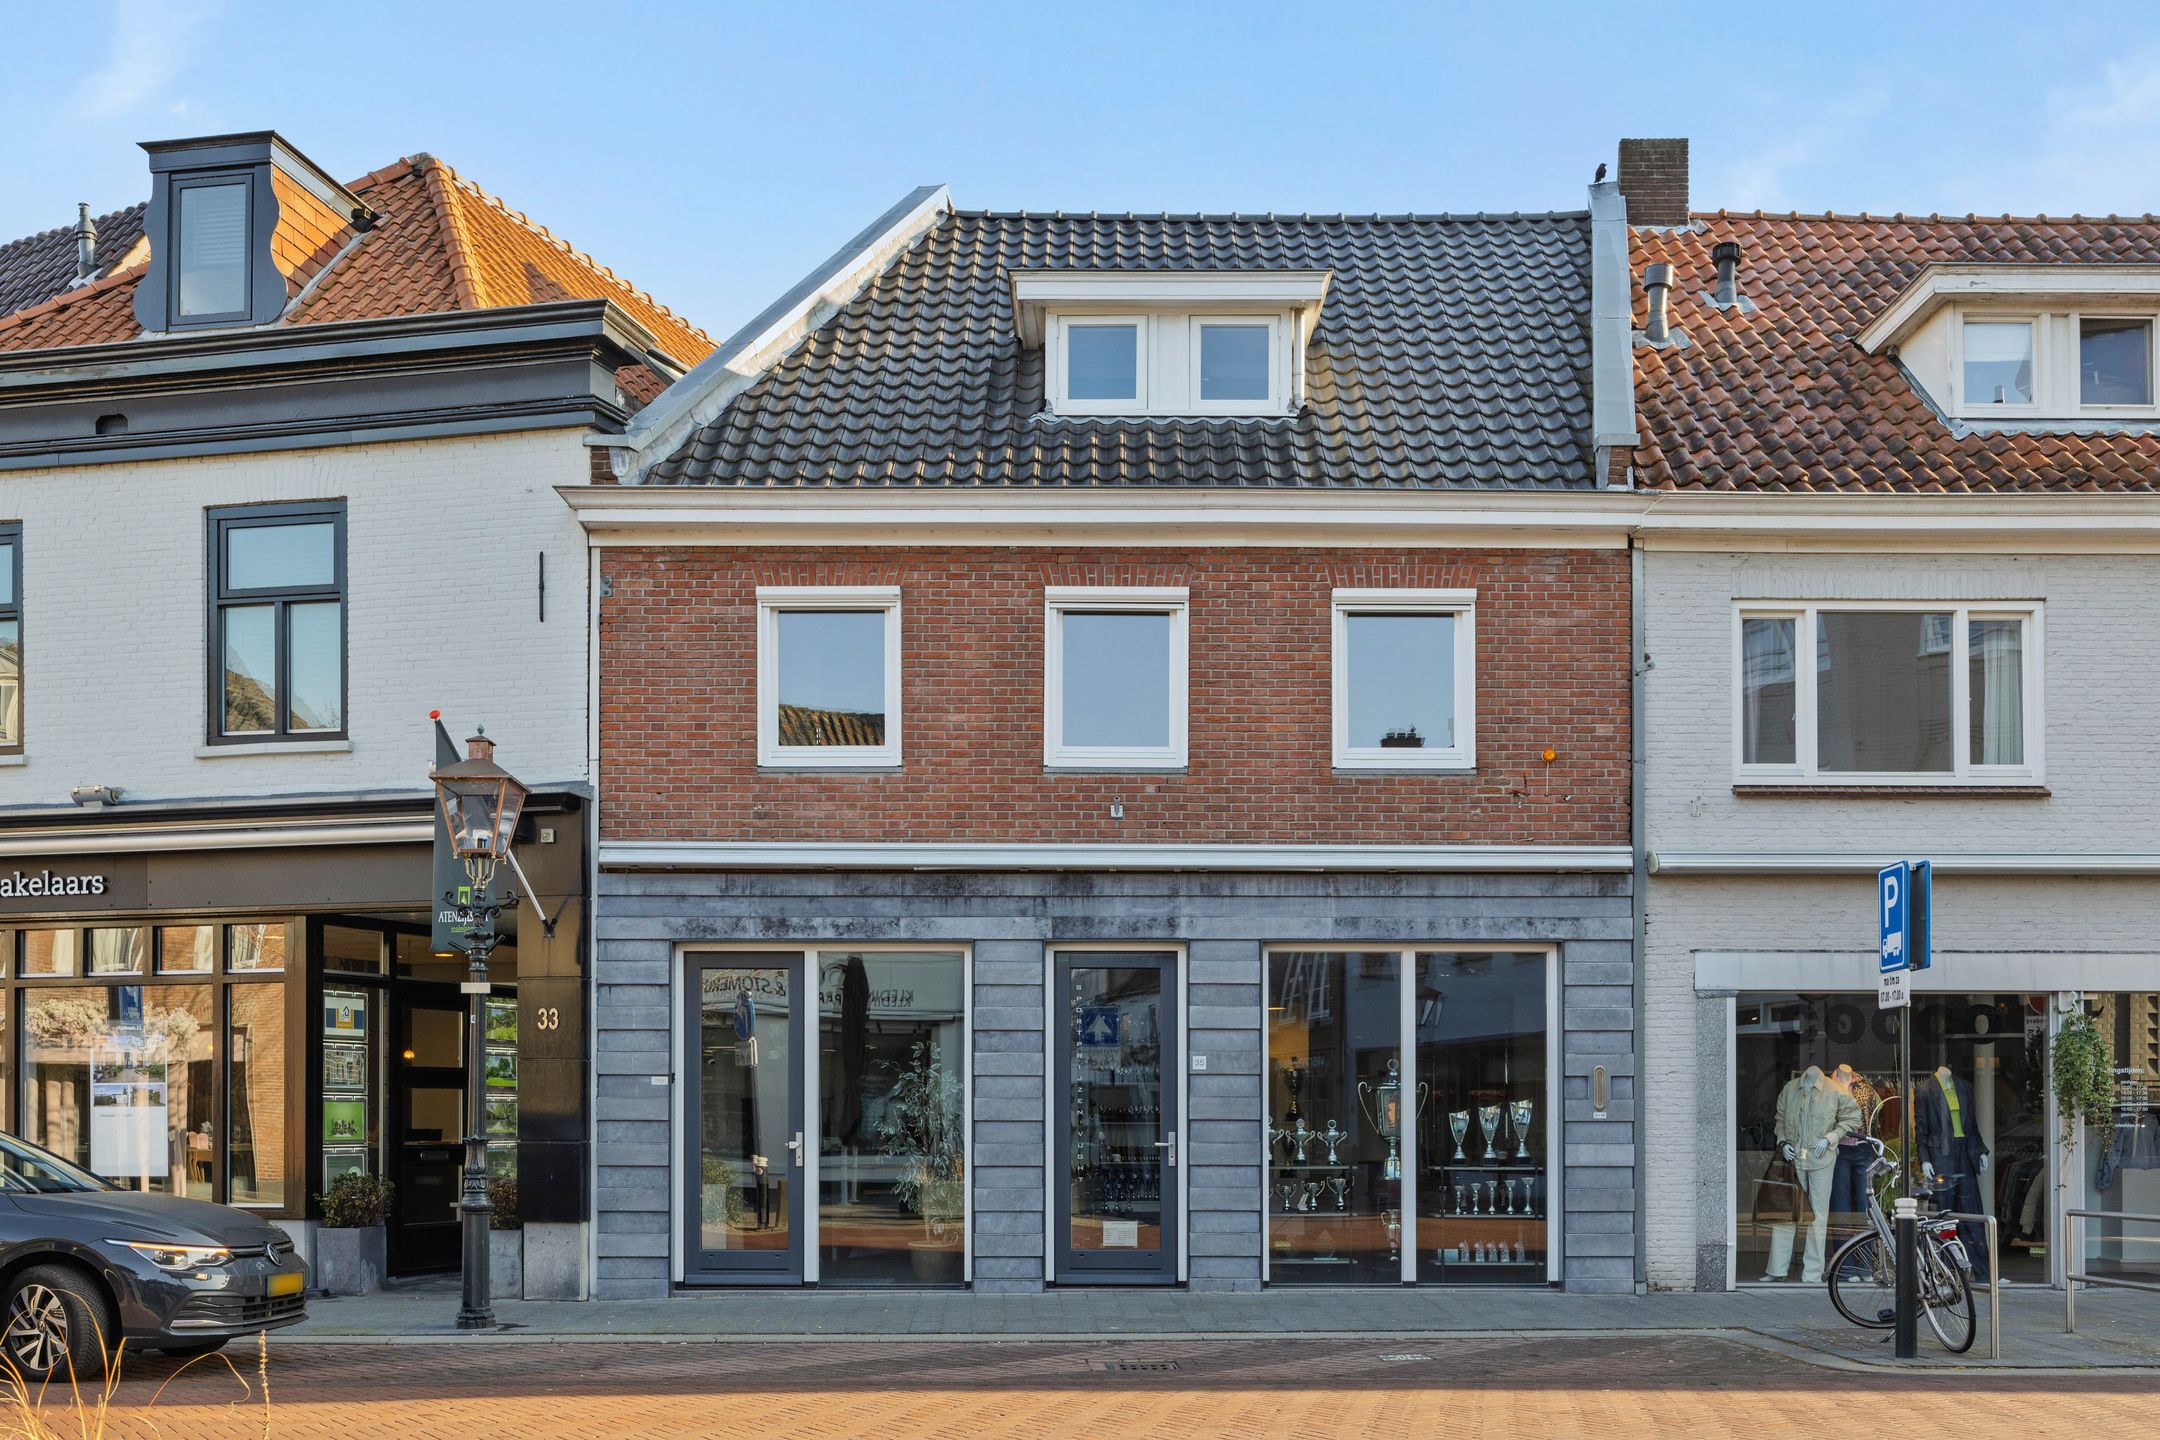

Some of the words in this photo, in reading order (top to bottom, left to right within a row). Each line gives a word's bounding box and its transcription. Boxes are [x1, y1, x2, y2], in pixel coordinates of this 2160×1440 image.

[0, 870, 104, 897] akelaars
[1884, 876, 1899, 928] P
[538, 1007, 559, 1030] 33
